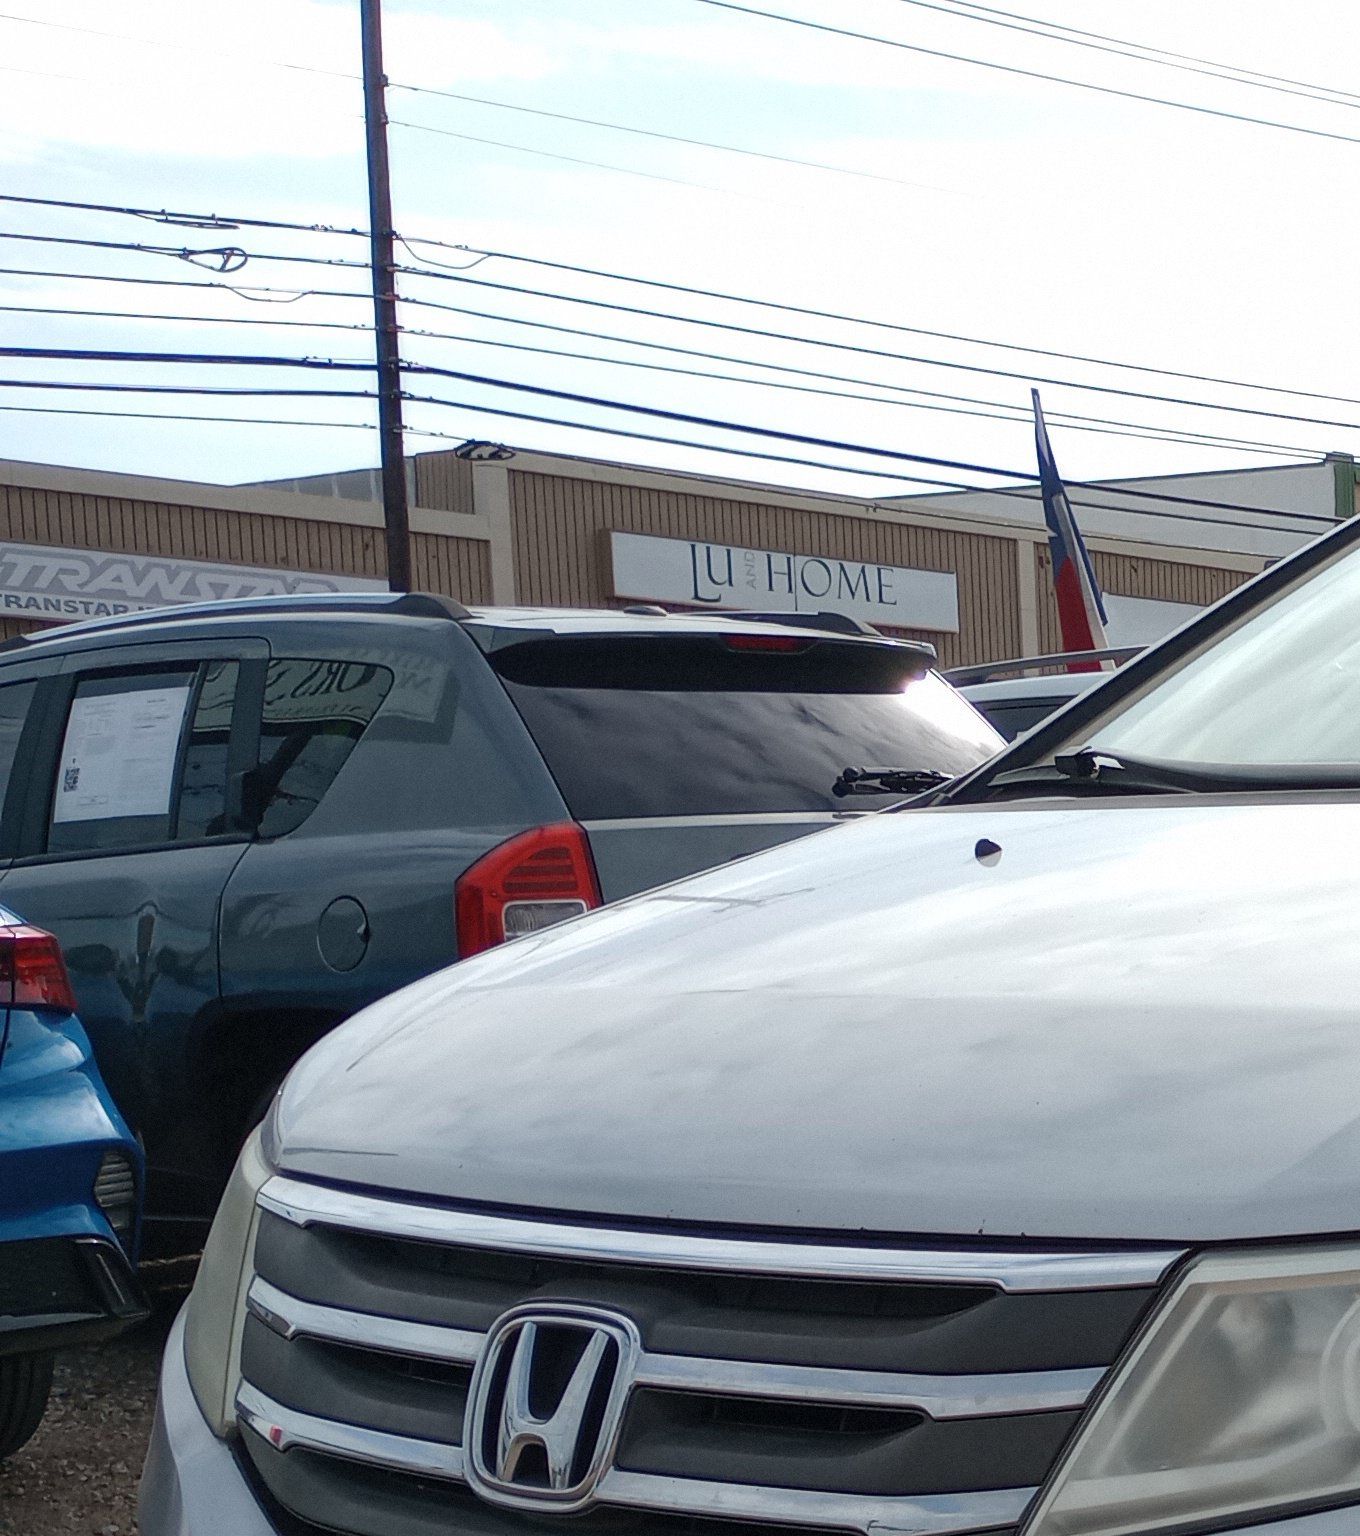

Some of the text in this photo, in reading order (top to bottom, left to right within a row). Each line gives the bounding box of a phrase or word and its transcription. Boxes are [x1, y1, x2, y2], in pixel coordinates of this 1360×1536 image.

[0, 552, 341, 600] TRANSTA
[766, 553, 898, 606] HOME
[0, 593, 130, 617] RANSTAR
